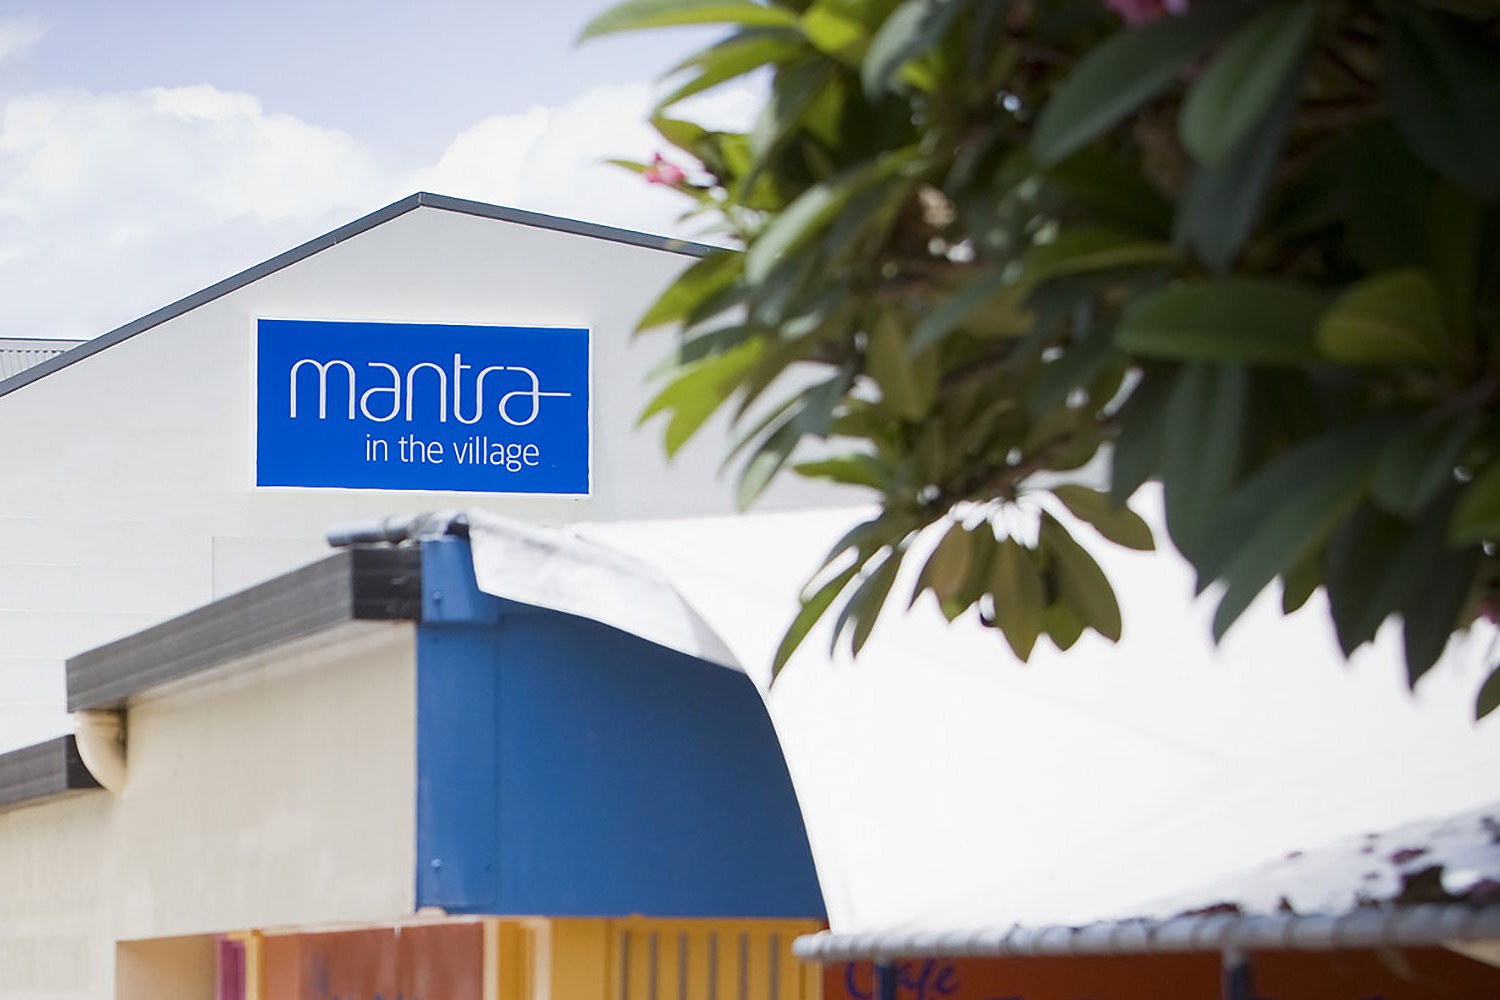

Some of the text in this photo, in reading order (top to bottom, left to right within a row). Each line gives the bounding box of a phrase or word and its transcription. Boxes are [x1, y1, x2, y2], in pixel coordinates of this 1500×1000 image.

[290, 353, 572, 426] mantra
[366, 433, 540, 472] in the village
